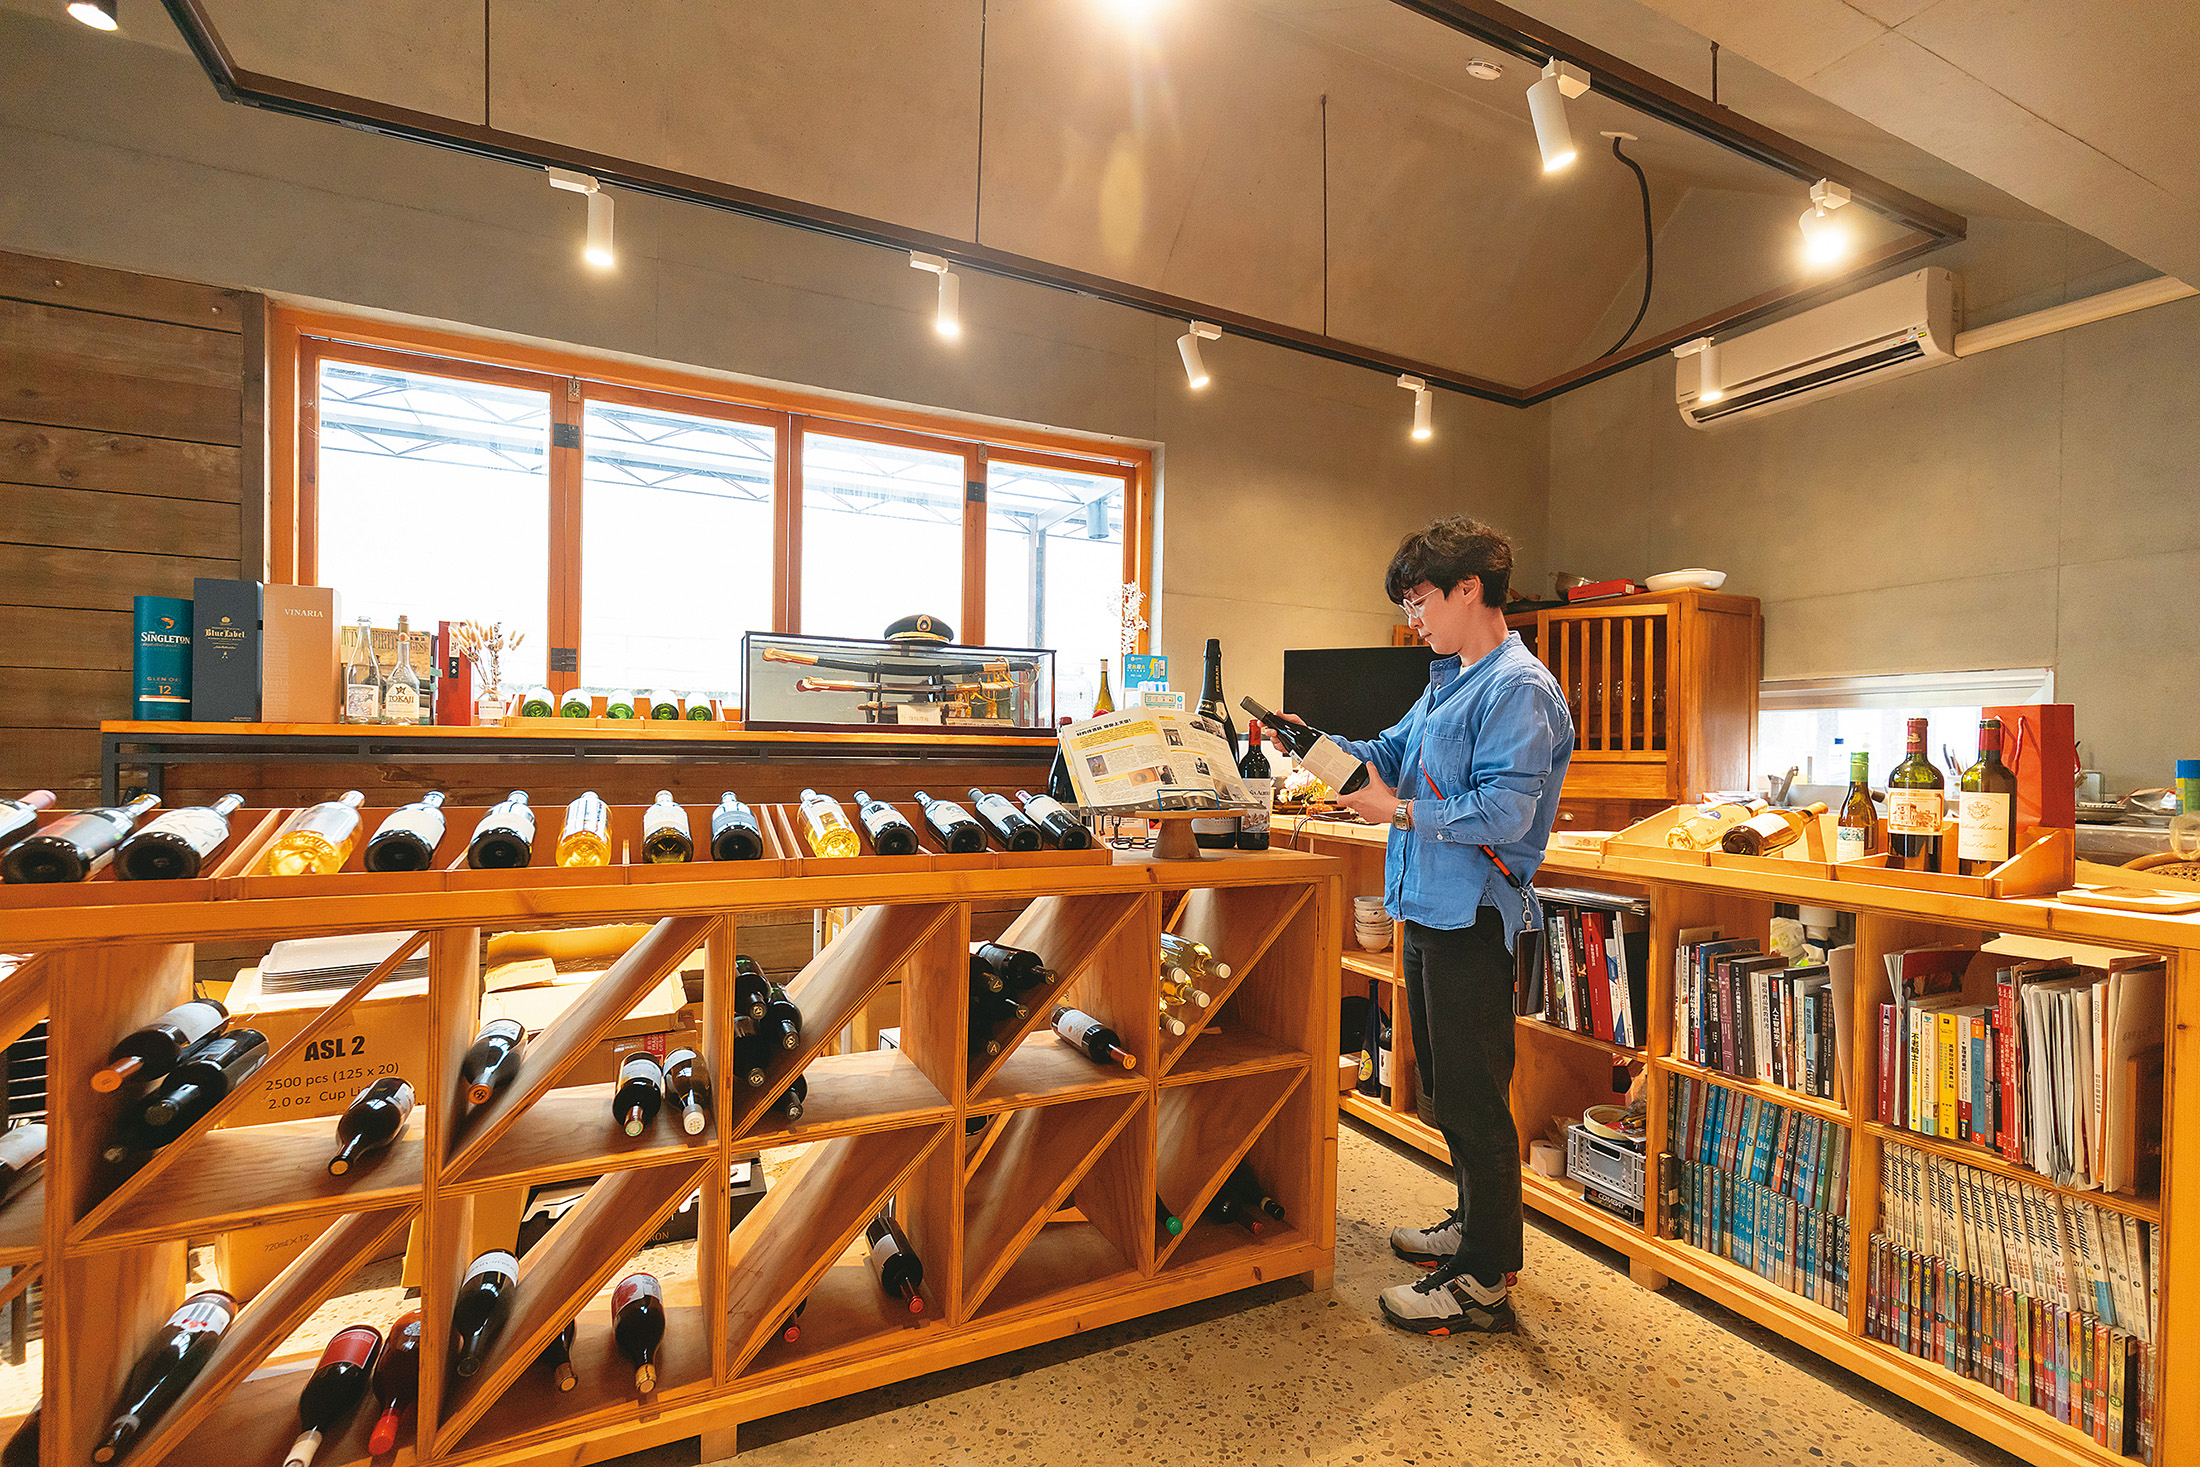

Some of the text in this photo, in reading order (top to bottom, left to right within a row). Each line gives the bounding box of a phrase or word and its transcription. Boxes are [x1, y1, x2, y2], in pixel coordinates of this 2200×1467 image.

[284, 608, 323, 618] VINARIA
[140, 631, 191, 645] SINGLETON
[205, 629, 224, 637] Blue
[158, 685, 172, 695] 12
[388, 696, 414, 704] TOKAJI
[304, 1036, 365, 1062] ASL 2
[265, 1062, 399, 1091] 2500 pcs (125 x 20)
[268, 1097, 291, 1110] 2.0
[295, 1096, 312, 1106] oz
[319, 1089, 346, 1102] Cup
[300, 1233, 309, 1242] 12
[649, 1231, 669, 1242] RON
